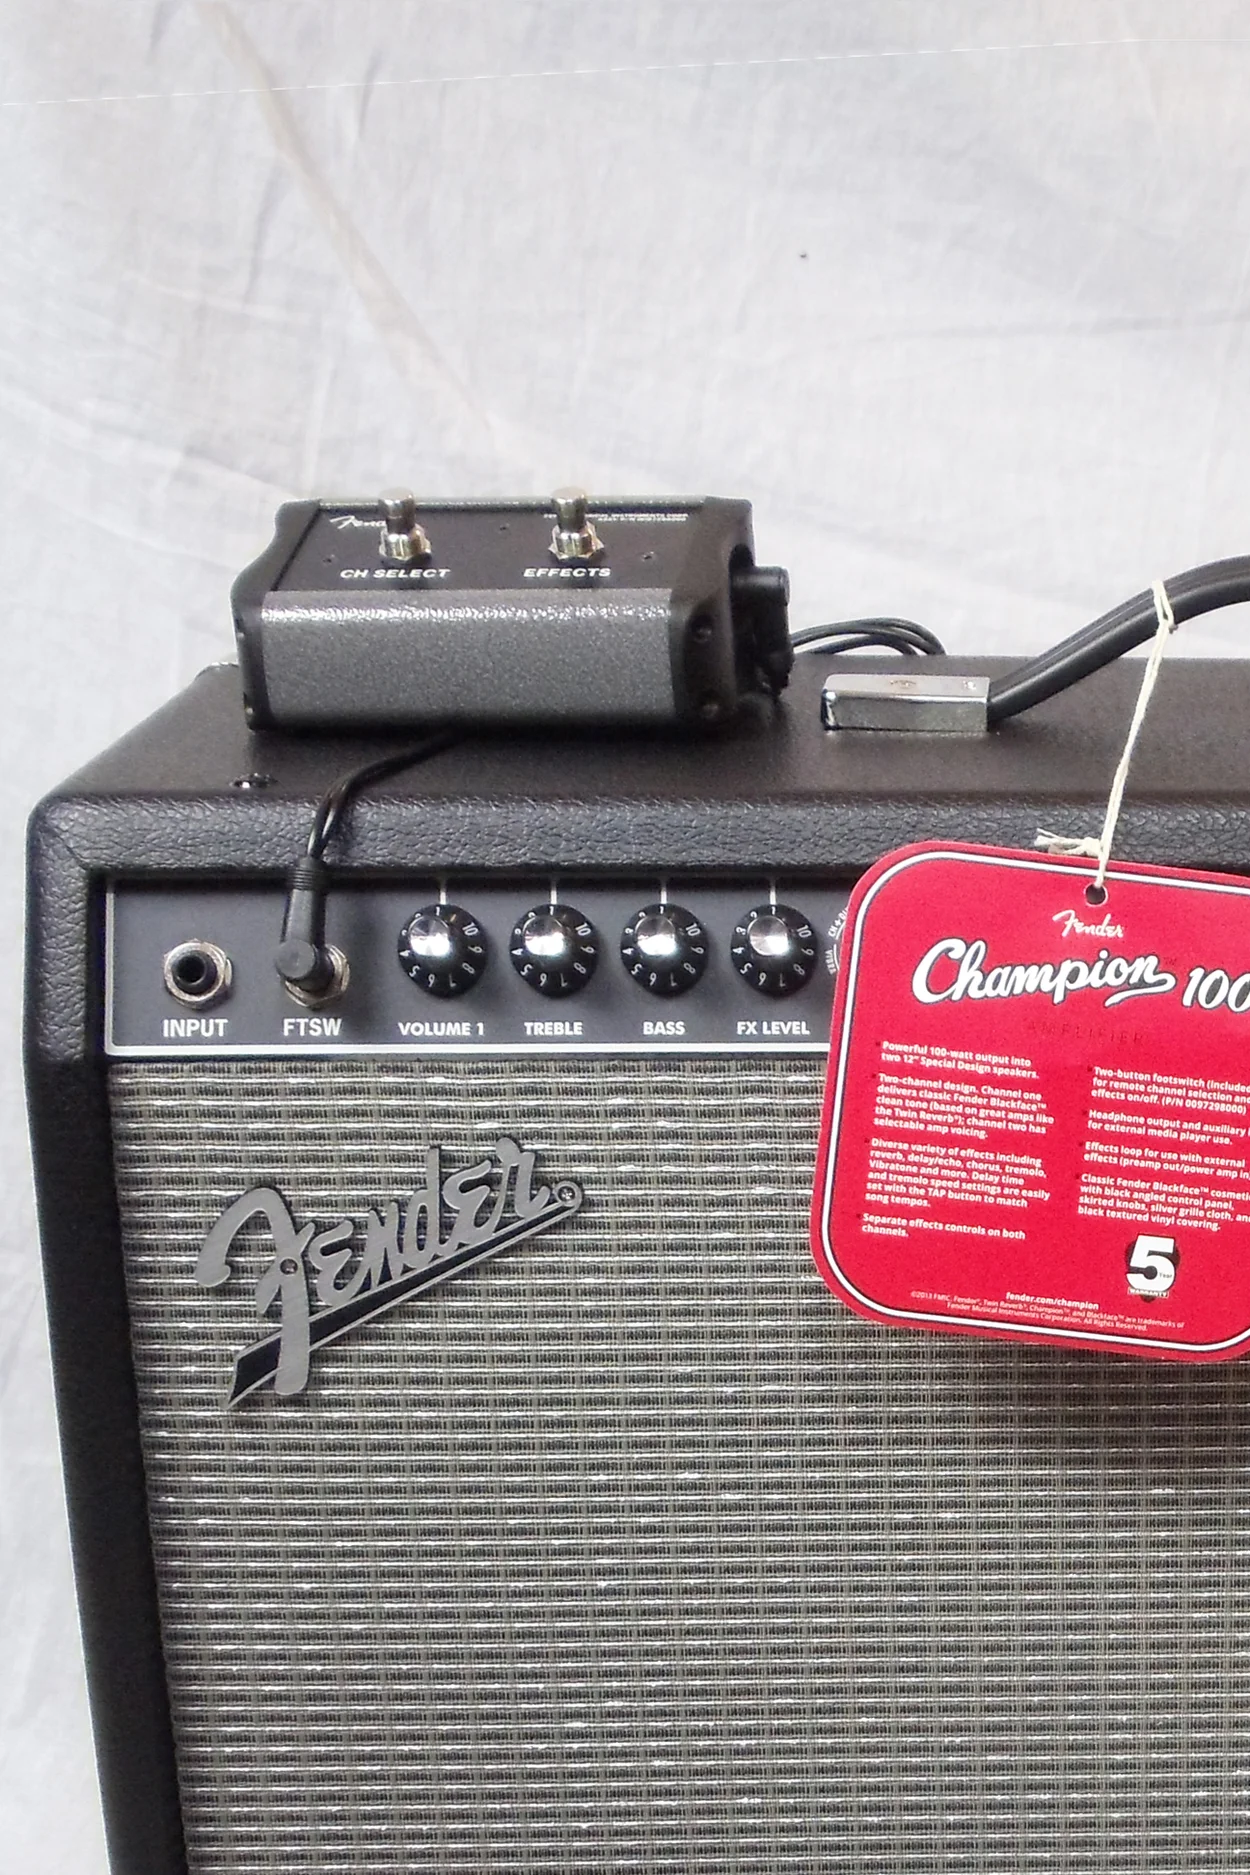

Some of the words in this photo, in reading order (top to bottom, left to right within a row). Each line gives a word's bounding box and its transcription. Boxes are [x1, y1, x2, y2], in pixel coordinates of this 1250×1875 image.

[340, 569, 369, 579] CH
[373, 568, 451, 578] SELECT
[523, 568, 611, 577] EFFECTS
[1052, 909, 1124, 938] Fender
[163, 1019, 229, 1037] INPUT
[283, 1018, 342, 1037] FTSW
[398, 1022, 471, 1036] VOLUME
[477, 1022, 484, 1035] 1
[524, 1021, 583, 1035] TREBLE
[643, 1021, 686, 1035] BASS
[737, 1021, 758, 1035] FX
[762, 1021, 810, 1035] LEVEL
[881, 1052, 901, 1062] two
[920, 1056, 956, 1068] Special
[957, 1060, 991, 1074] Design
[993, 1066, 1039, 1078] speakers.
[882, 1041, 928, 1055] Powerful
[930, 1047, 973, 1060] 100-watt
[975, 1053, 1009, 1064] output
[1011, 1056, 1031, 1067] into
[879, 1073, 942, 1088] Two-channel
[943, 1081, 978, 1094] design.
[981, 1085, 1022, 1098] Channel
[1023, 1092, 1042, 1101] one
[1093, 1077, 1108, 1087] for
[1109, 1081, 1145, 1092] remote
[1147, 1084, 1186, 1096] channel
[1188, 1089, 1232, 1102] selection
[1094, 1066, 1151, 1081] Two-button
[1153, 1073, 1205, 1088] footswitch
[877, 1084, 917, 1097] delivers
[919, 1089, 951, 1101] classic
[953, 1093, 988, 1105] Fender
[1091, 1088, 1125, 1100] effects
[1127, 1094, 1159, 1104] on/off.
[1161, 1096, 1184, 1107] (P/N
[875, 1106, 893, 1116] the
[894, 1108, 918, 1119] Twin
[966, 1116, 1006, 1129] channel
[1008, 1122, 1027, 1131] two
[1028, 1123, 1046, 1134] has
[876, 1095, 903, 1106] clean
[905, 1099, 928, 1109] tone
[929, 1101, 963, 1113] (based
[964, 1107, 978, 1115] on
[978, 1108, 1006, 1118] great
[1007, 1112, 1034, 1122] amps
[1036, 1113, 1054, 1124] like
[874, 1117, 925, 1130] selectable
[926, 1124, 949, 1135] amp
[950, 1126, 988, 1139] voicing.
[1088, 1120, 1103, 1129] for
[1104, 1123, 1146, 1135] external
[1147, 1129, 1178, 1138] media
[1180, 1131, 1211, 1143] player
[1213, 1136, 1232, 1144] use.
[1089, 1110, 1145, 1124] Headphone
[1147, 1118, 1181, 1128] output
[1182, 1122, 1201, 1130] and
[1203, 1124, 1246, 1137] auxiliary
[870, 1150, 905, 1162] reverb,
[907, 1153, 964, 1168] delay/echo,
[966, 1160, 1002, 1173] chorus,
[1005, 1165, 1046, 1178] tremolo,
[871, 1138, 909, 1150] Diverse
[911, 1144, 947, 1156] variety
[948, 1147, 959, 1156] of
[960, 1148, 995, 1160] effects
[996, 1152, 1042, 1168] including
[1084, 1152, 1118, 1164] effects
[1119, 1156, 1161, 1170] (preamp
[1163, 1163, 1215, 1175] out/power
[1216, 1169, 1238, 1179] amp
[1085, 1141, 1119, 1153] Effects
[1121, 1145, 1142, 1158] loop
[1144, 1148, 1159, 1158] for
[1161, 1152, 1178, 1160] use
[1180, 1153, 1202, 1163] with
[1204, 1157, 1245, 1168] external
[869, 1159, 918, 1173] Vibratone
[920, 1167, 939, 1175] and
[940, 1169, 969, 1179] more.
[972, 1171, 1000, 1184] Delay
[1001, 1175, 1024, 1185] time
[1081, 1173, 1114, 1185] Classic
[1117, 1177, 1151, 1189] Fender
[867, 1182, 882, 1191] set
[884, 1183, 907, 1193] with
[908, 1185, 926, 1196] the
[927, 1187, 946, 1197] TAP
[947, 1190, 982, 1202] button
[984, 1195, 995, 1203] to
[996, 1197, 1028, 1207] match
[868, 1171, 887, 1180] and
[889, 1173, 929, 1185] tremolo
[930, 1179, 960, 1189] speed
[961, 1182, 1001, 1195] settings
[1003, 1187, 1020, 1196] are
[1021, 1189, 1050, 1201] easily
[1080, 1185, 1102, 1194] with
[1104, 1186, 1131, 1198] black
[1132, 1192, 1166, 1202] angled
[1167, 1196, 1203, 1206] control
[1204, 1200, 1234, 1211] panel,
[865, 1193, 889, 1204] song
[891, 1195, 930, 1207] tempos.
[1079, 1195, 1114, 1207] skirted
[1116, 1199, 1148, 1211] knobs,
[1151, 1203, 1178, 1214] silver
[1179, 1207, 1205, 1217] grille
[1206, 1210, 1233, 1221] cloth,
[862, 1224, 908, 1237] channels.
[863, 1213, 907, 1226] Separate
[909, 1219, 943, 1230] effects
[945, 1224, 986, 1235] controls
[1002, 1228, 1025, 1239] both
[1078, 1205, 1104, 1216] black
[1106, 1209, 1149, 1221] textured
[1151, 1214, 1175, 1226] vinyl
[1176, 1218, 1220, 1232] covering.
[195, 1137, 551, 1395] Fender
[1126, 1235, 1175, 1292] 5
[1006, 1292, 1099, 1310] fender.com/champion
